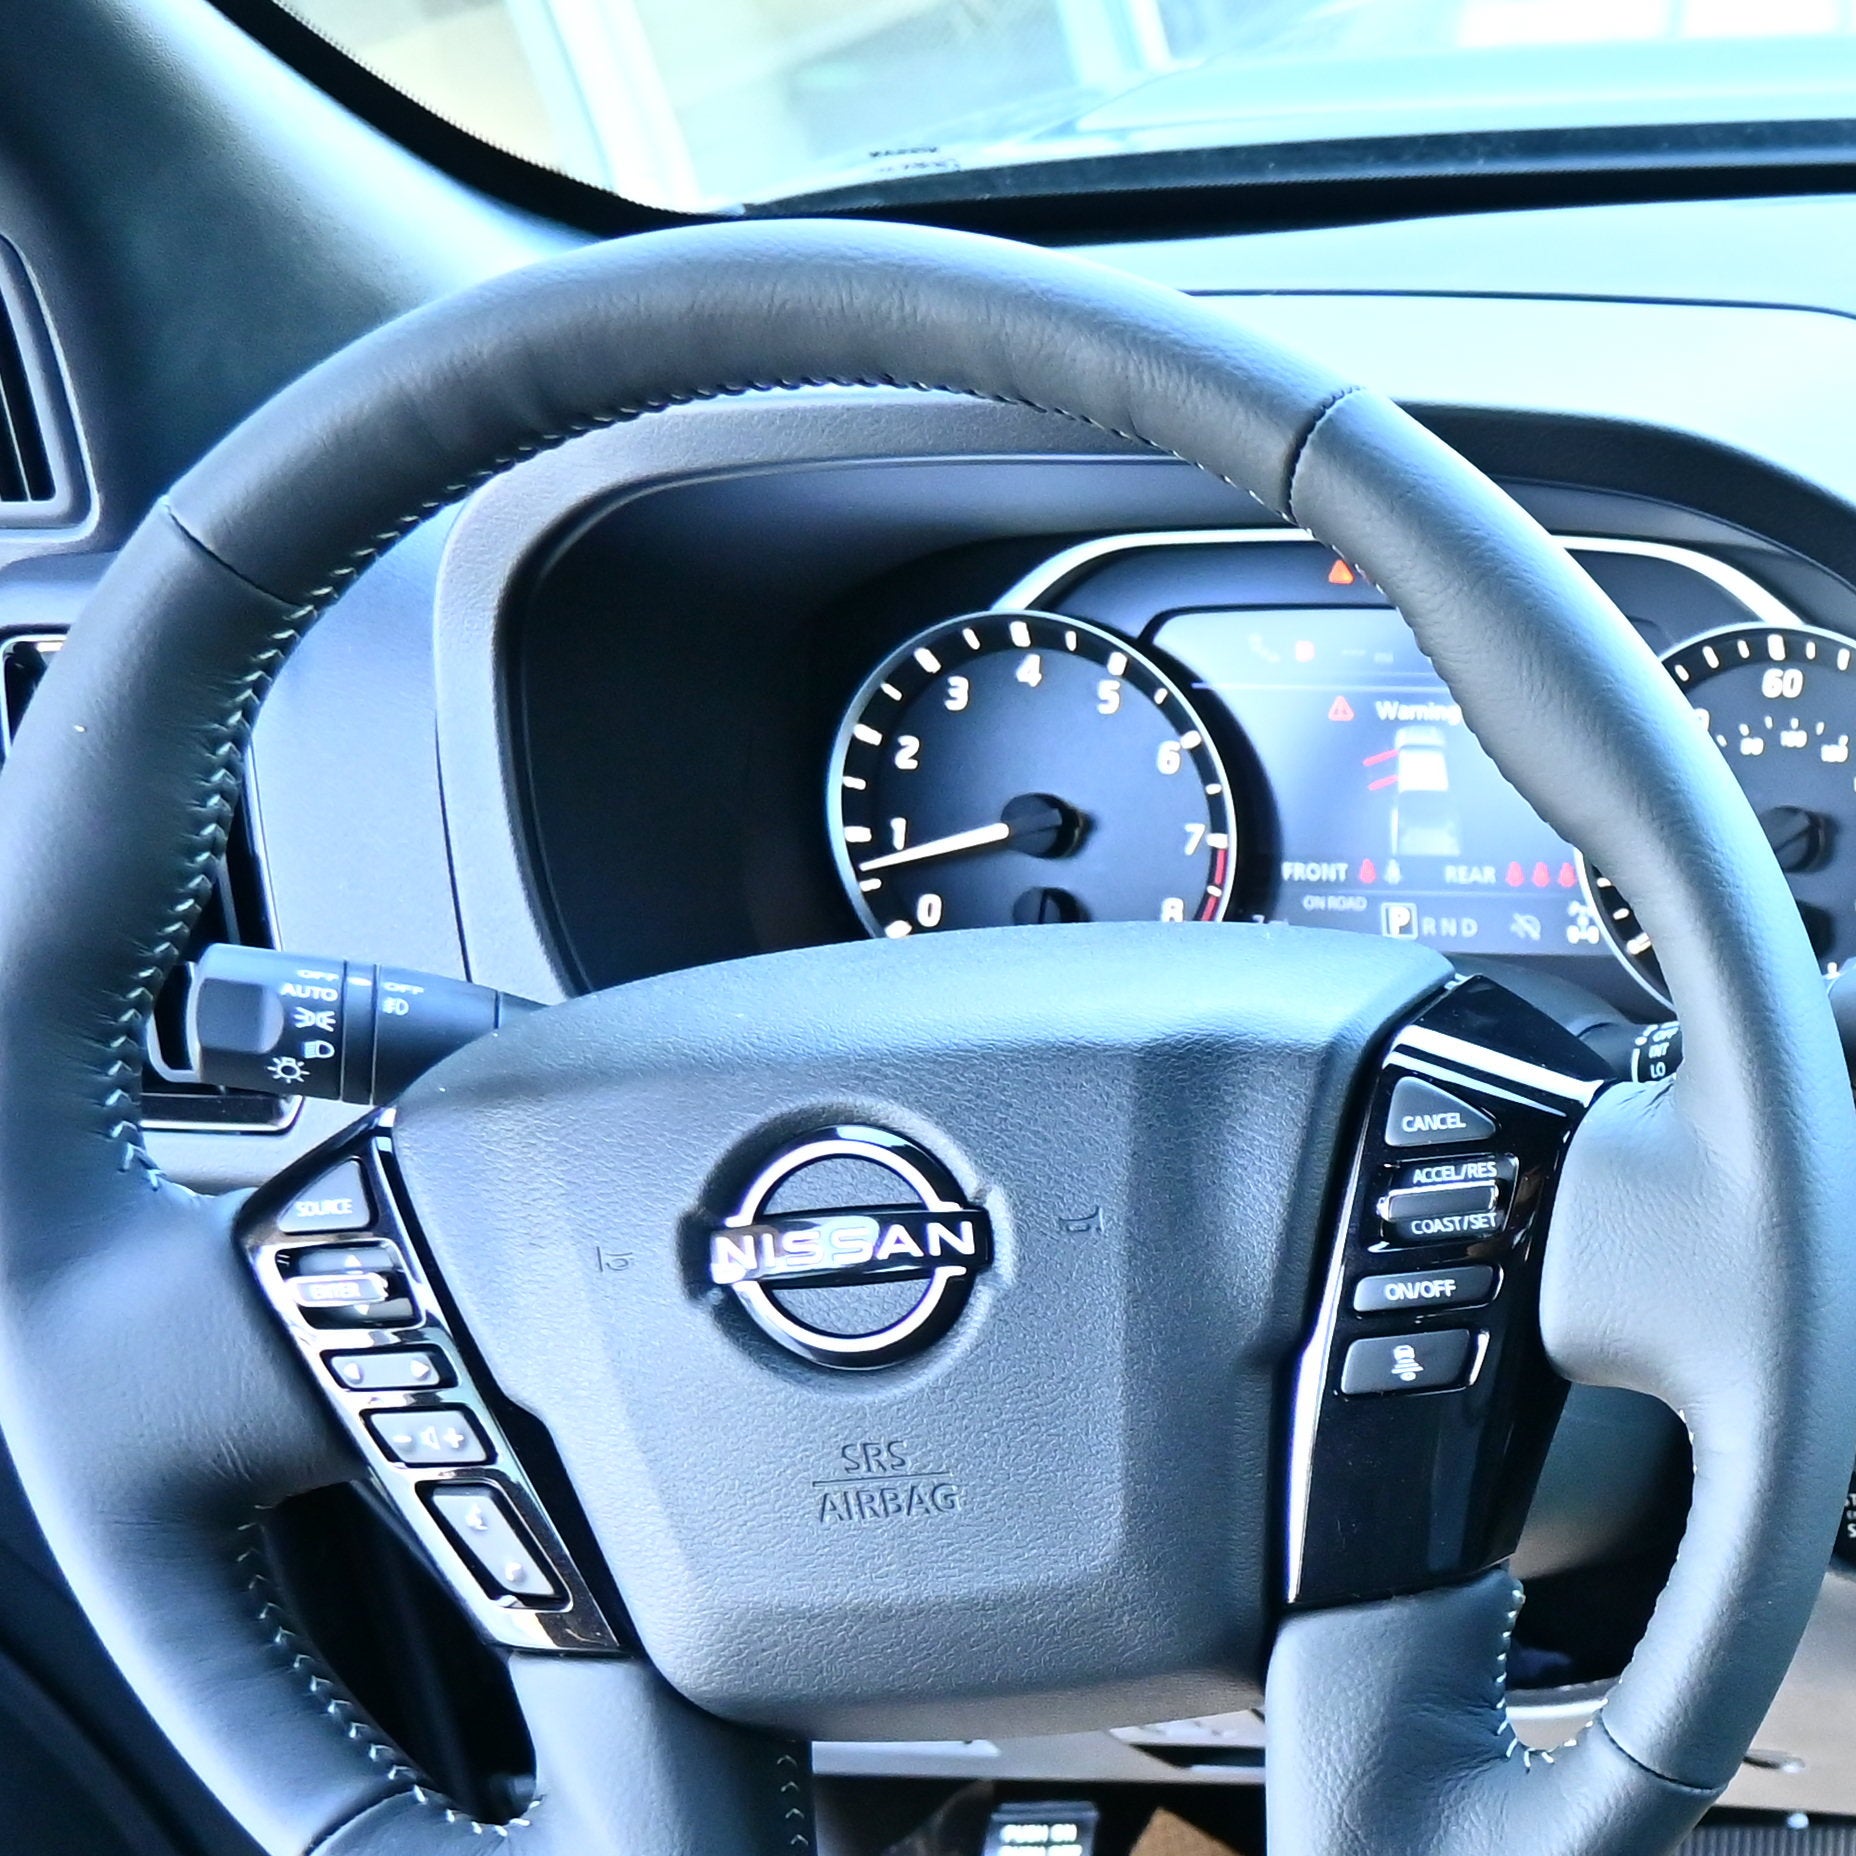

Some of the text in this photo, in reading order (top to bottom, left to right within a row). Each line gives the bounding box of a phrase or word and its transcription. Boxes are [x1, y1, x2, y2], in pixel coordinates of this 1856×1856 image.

[1016, 654, 1042, 687] 4
[1761, 668, 1803, 698] 60
[944, 676, 970, 711] 3
[1097, 681, 1121, 714] 5
[1375, 701, 1462, 726] Warning
[895, 735, 920, 770] 2
[1156, 740, 1180, 775] 6
[890, 817, 906, 850] 1
[1184, 823, 1206, 855] 7
[1281, 862, 1349, 882] FRONT
[1445, 865, 1497, 884] REAR
[917, 894, 942, 927] 0
[1303, 895, 1368, 911] ON ROAD
[1385, 906, 1478, 937] P R N D
[297, 969, 339, 981] OFF
[382, 982, 424, 994] OFF
[281, 983, 338, 1001] AUTO
[1650, 1062, 1666, 1078] LO
[1401, 1112, 1467, 1132] CANCEL
[1413, 1162, 1497, 1184] ACCEL/RES
[295, 1198, 353, 1217] SOURCE
[1411, 1212, 1497, 1235] COAST/SET
[713, 1220, 976, 1270] NISSAN
[1384, 1280, 1456, 1300] ON/OFF
[841, 1440, 909, 1474] SRS
[819, 1482, 961, 1524] AIRBAG
